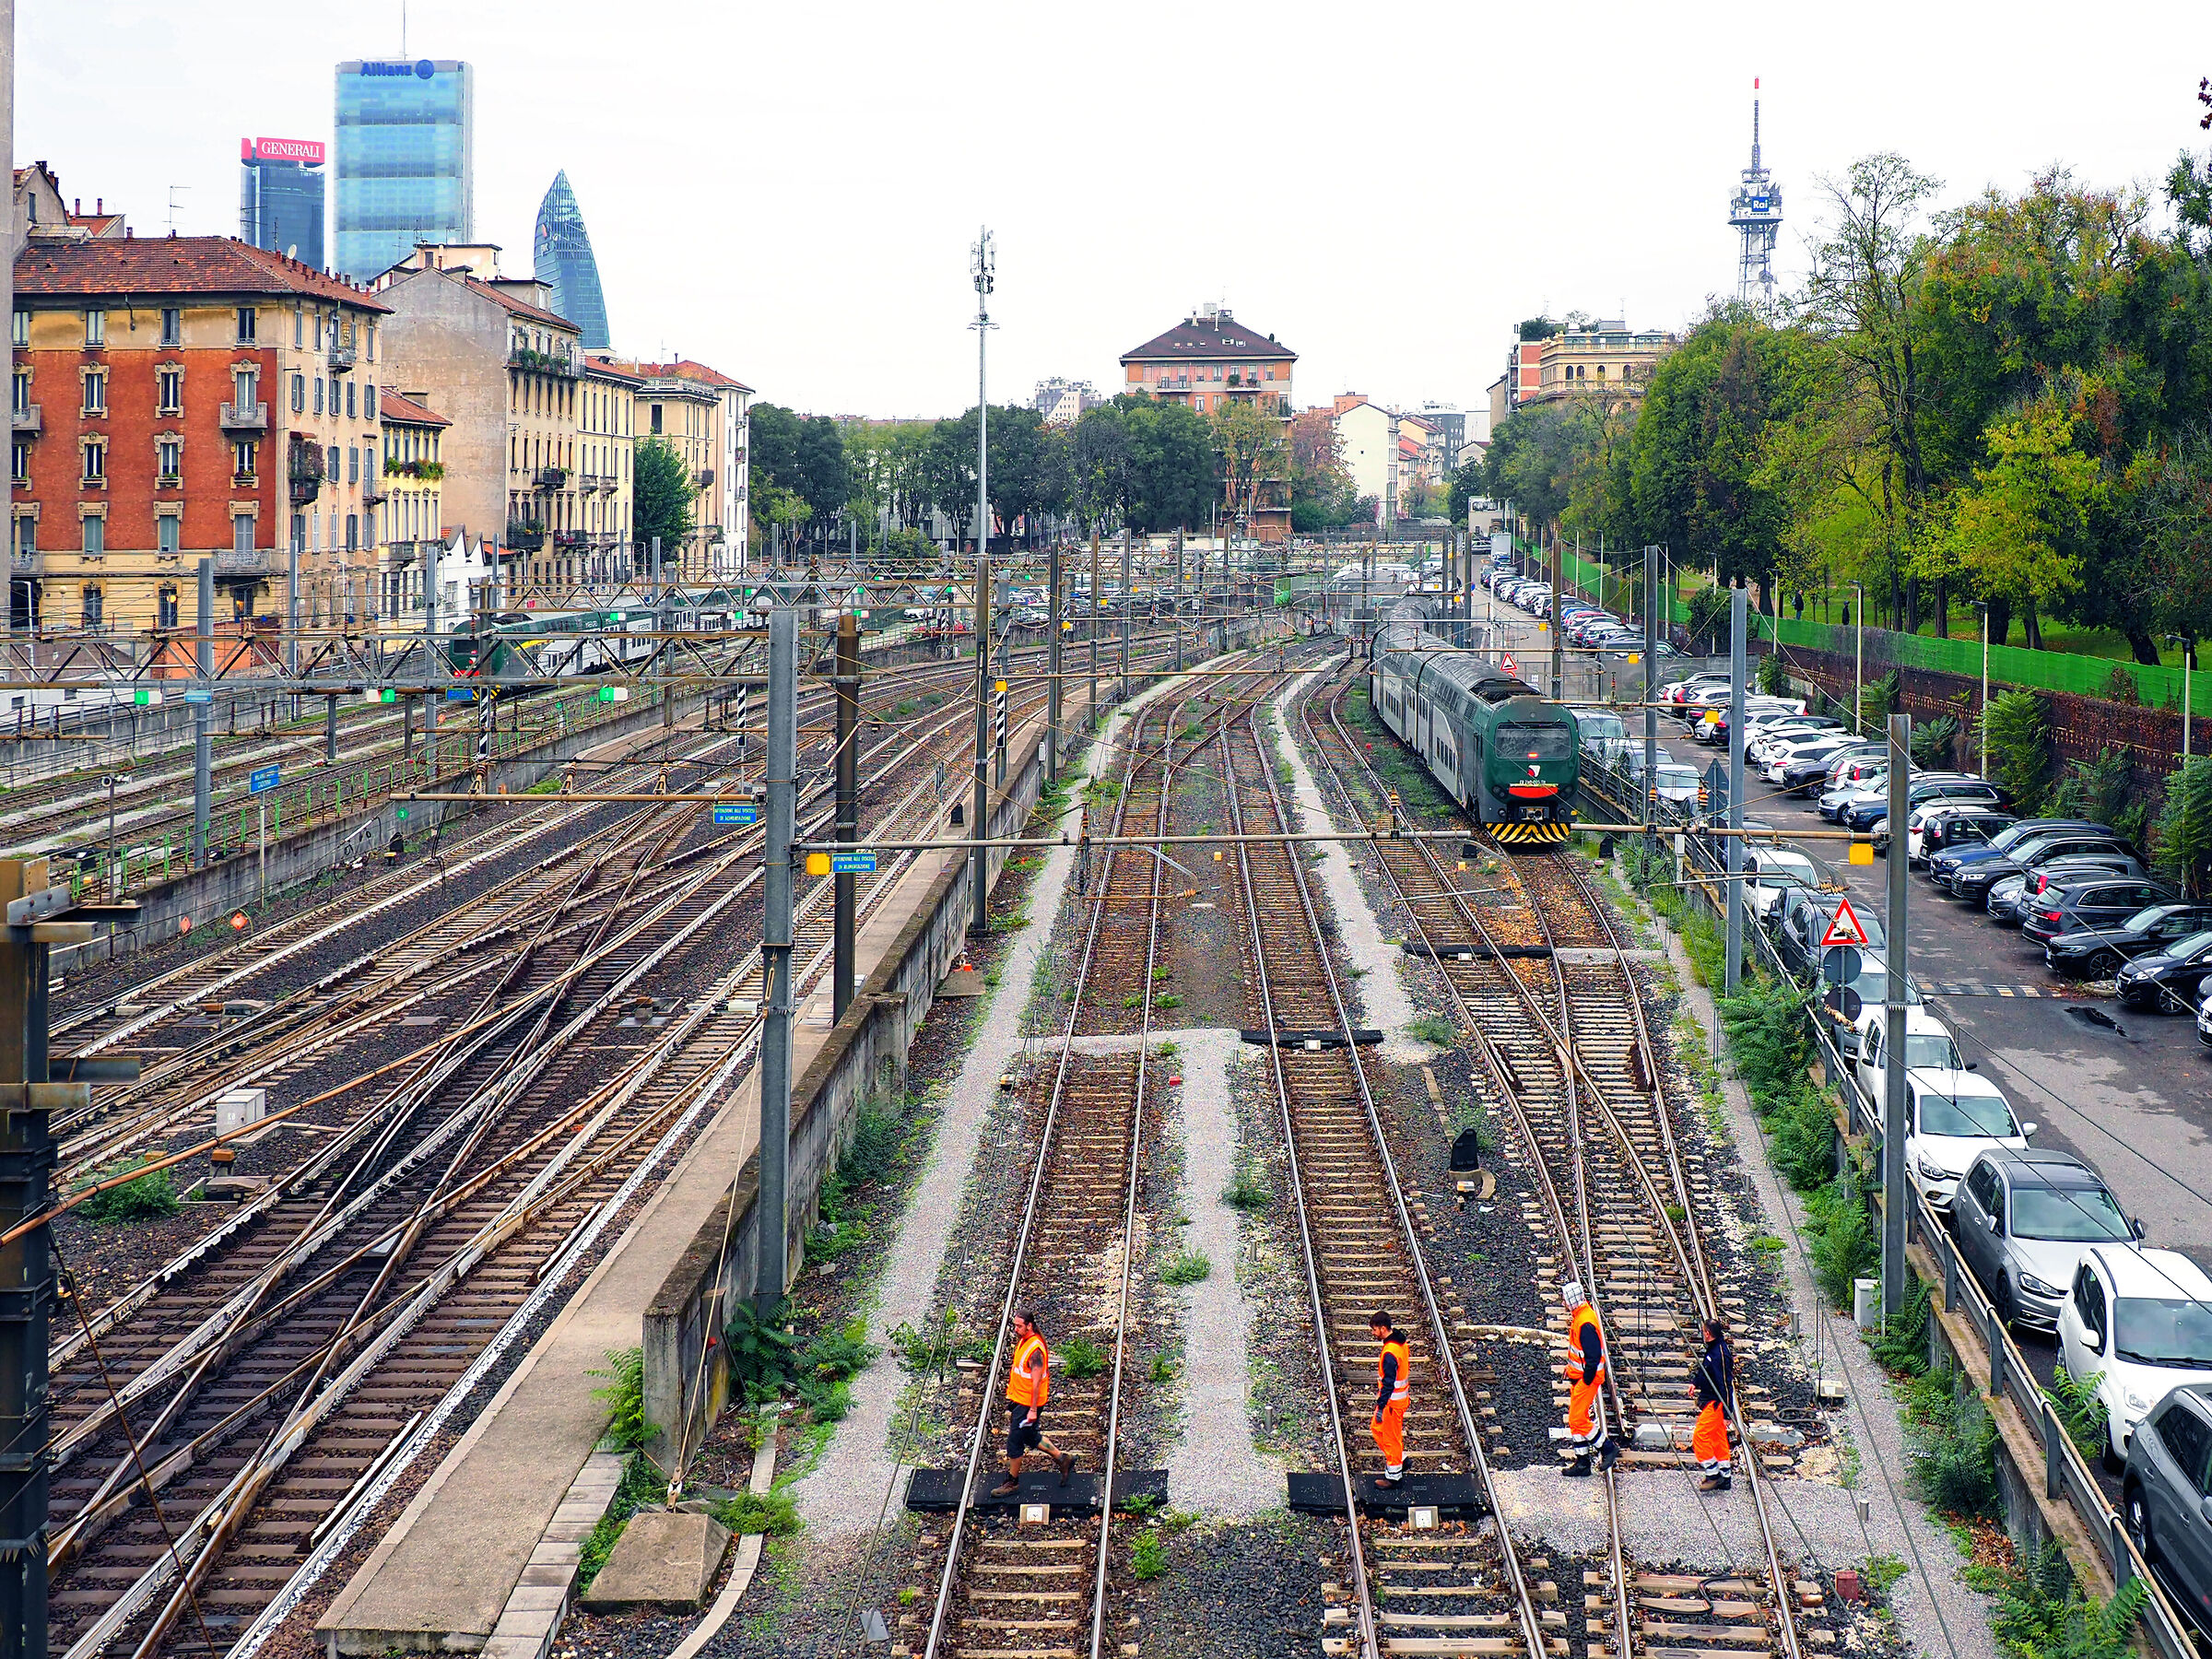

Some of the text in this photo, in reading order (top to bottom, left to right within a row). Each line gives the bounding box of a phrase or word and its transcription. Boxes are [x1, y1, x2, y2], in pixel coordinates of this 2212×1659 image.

[360, 62, 413, 76] Allianz
[261, 141, 320, 159] GENERALI
[1753, 199, 1769, 209] Rai
